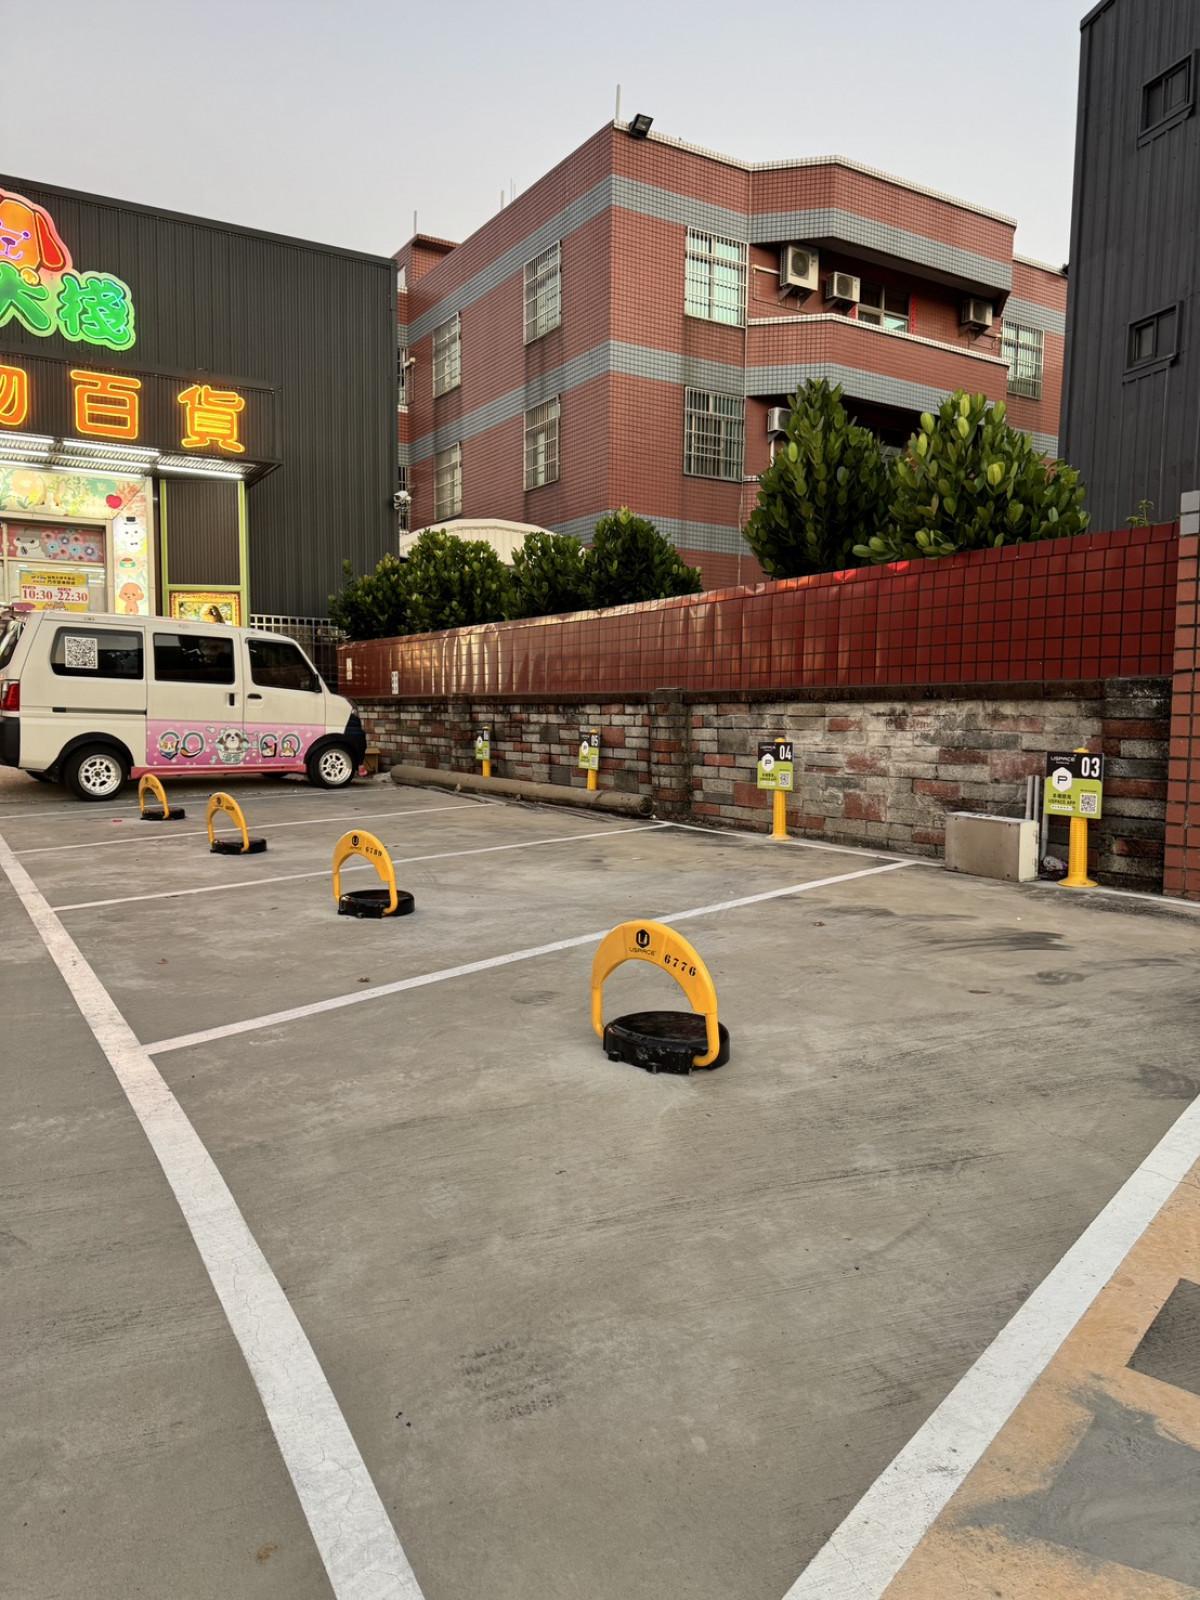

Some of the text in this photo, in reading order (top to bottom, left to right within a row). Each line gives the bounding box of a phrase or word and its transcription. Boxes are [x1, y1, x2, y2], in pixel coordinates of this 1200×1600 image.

[779, 745, 792, 760] 04
[1081, 757, 1099, 777] 03
[663, 953, 696, 976] 6776
